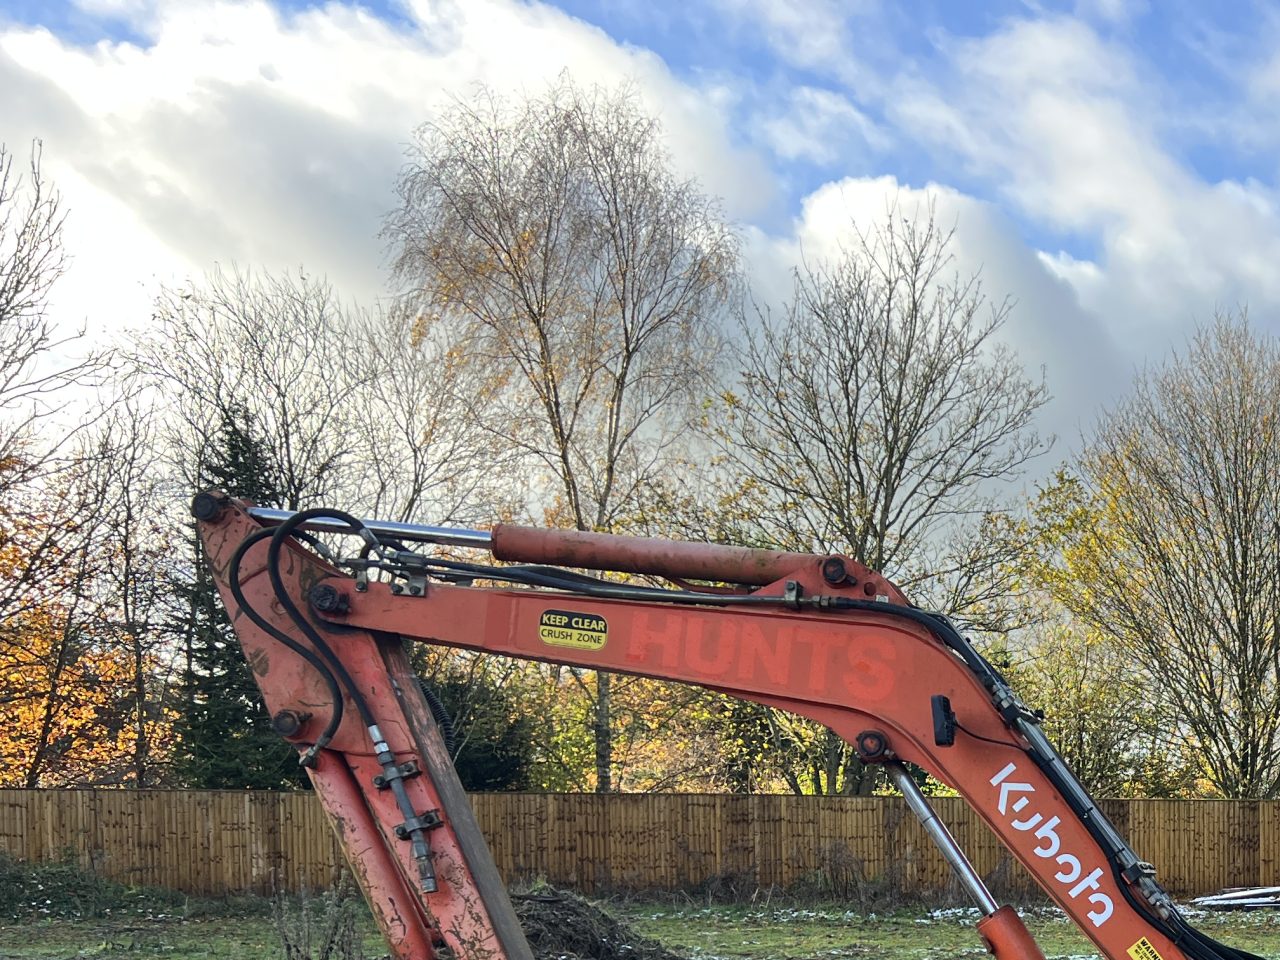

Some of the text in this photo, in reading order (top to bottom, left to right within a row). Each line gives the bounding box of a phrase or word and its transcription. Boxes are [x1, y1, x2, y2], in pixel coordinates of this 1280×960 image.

[541, 628, 573, 641] CRUSH
[577, 632, 603, 645] ZONE
[542, 614, 605, 631] KEEP CLEAR
[625, 611, 896, 700] HUNTS
[989, 762, 1114, 928] Kubota
